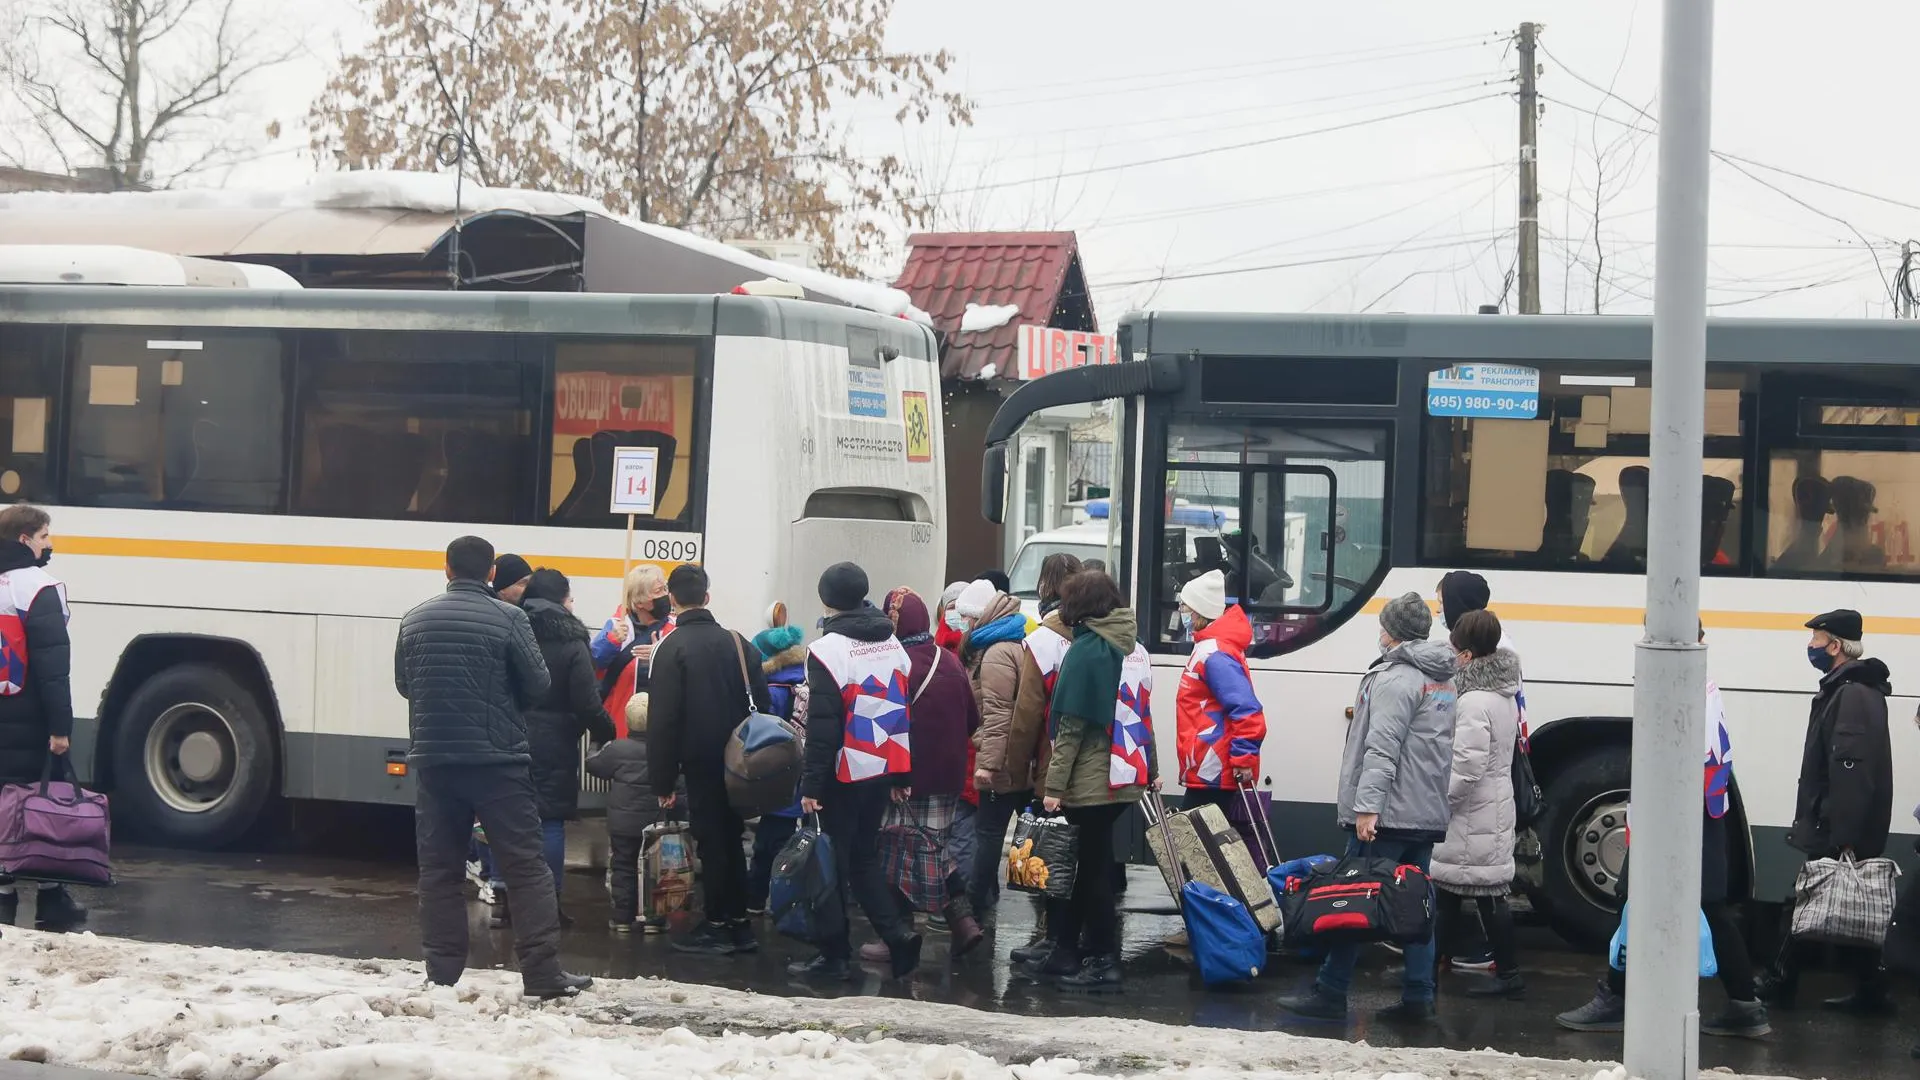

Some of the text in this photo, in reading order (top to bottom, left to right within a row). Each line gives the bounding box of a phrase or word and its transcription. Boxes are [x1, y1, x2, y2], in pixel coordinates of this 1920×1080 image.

[1480, 366, 1537, 376] РЕКЛАМА НА
[1481, 377, 1536, 387] ТРАНСПОРТЕ
[1428, 394, 1538, 411] (495) 980-90-40
[802, 437, 814, 455] 60
[836, 435, 903, 453] МОСТРАНСАВТО
[627, 476, 648, 496] 14
[911, 524, 931, 543] 0809
[644, 539, 697, 561] 0809
